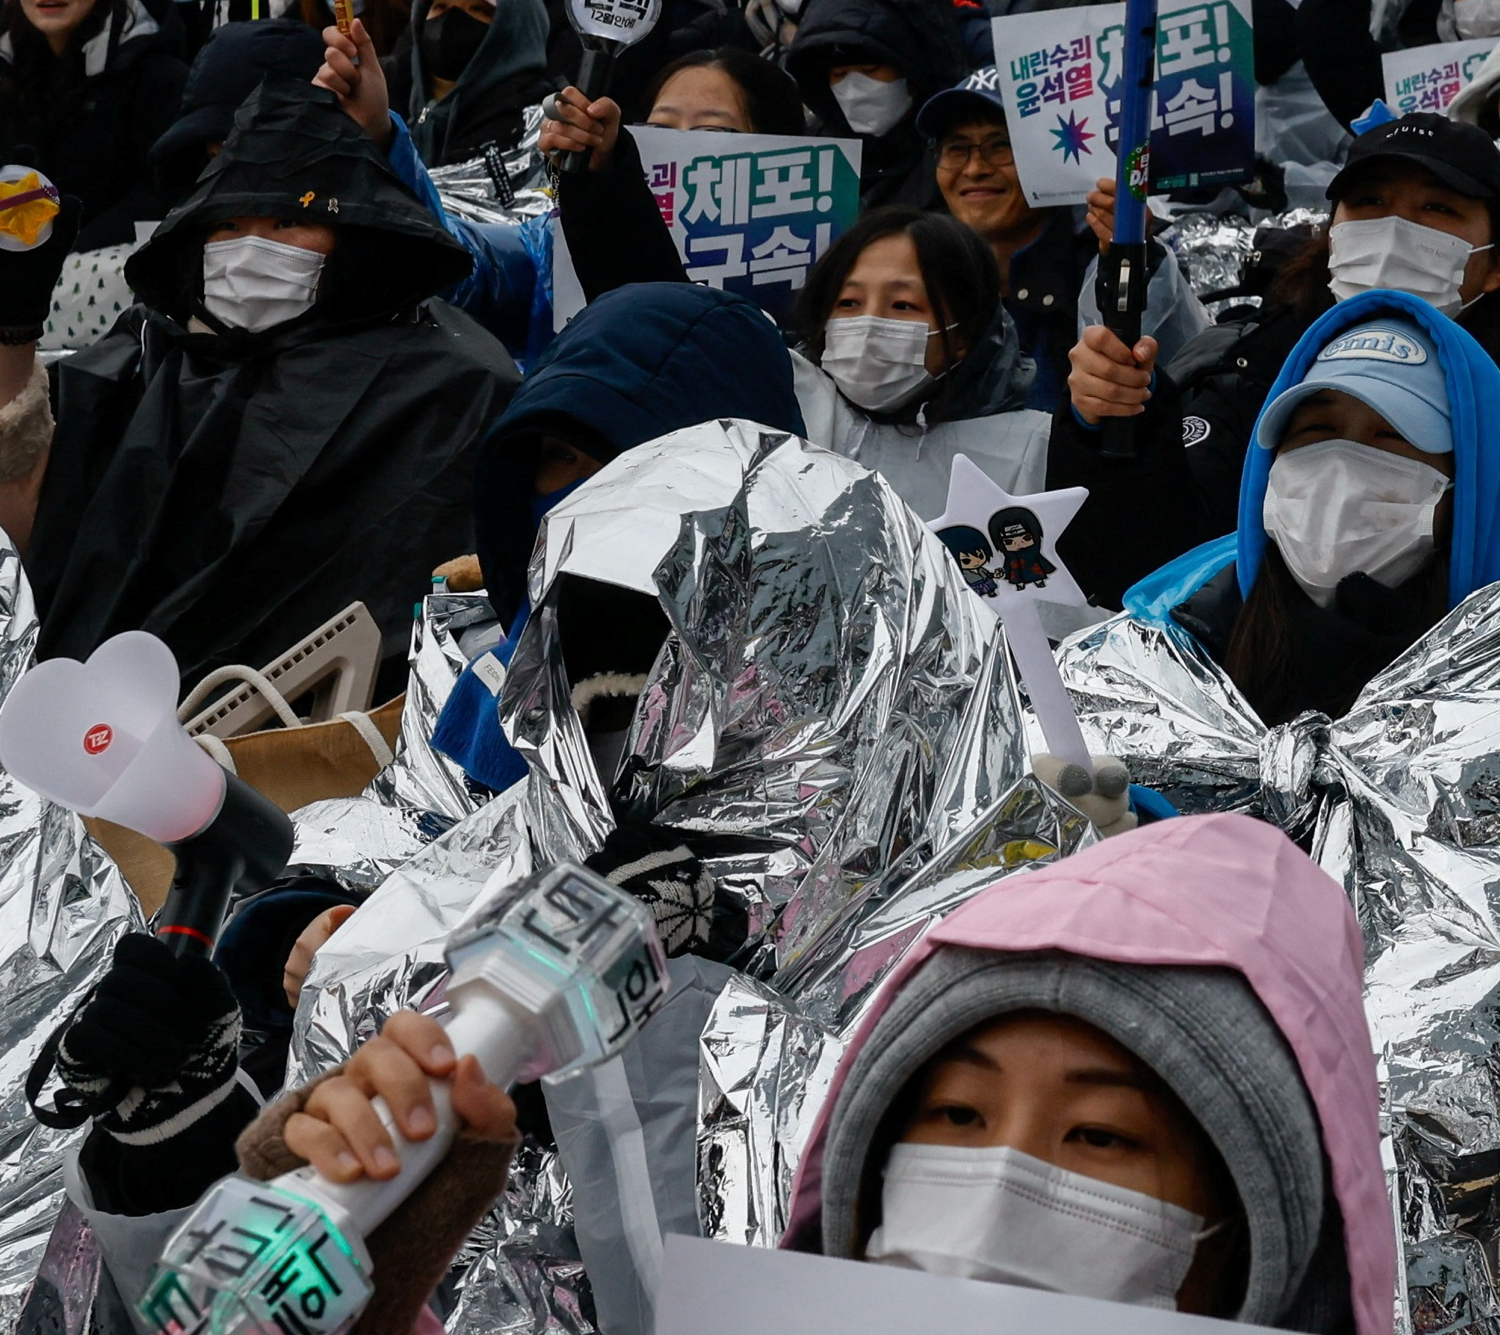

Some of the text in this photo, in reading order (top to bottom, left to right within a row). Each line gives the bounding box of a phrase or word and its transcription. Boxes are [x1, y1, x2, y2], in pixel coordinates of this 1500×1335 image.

[1009, 34, 1094, 84] 내란수괴
[1096, 1, 1232, 78] 포!
[1014, 56, 1096, 119] 윤석열
[1395, 60, 1461, 95] 내란수괴
[684, 145, 835, 226] 체포!
[1326, 331, 1412, 360] emis
